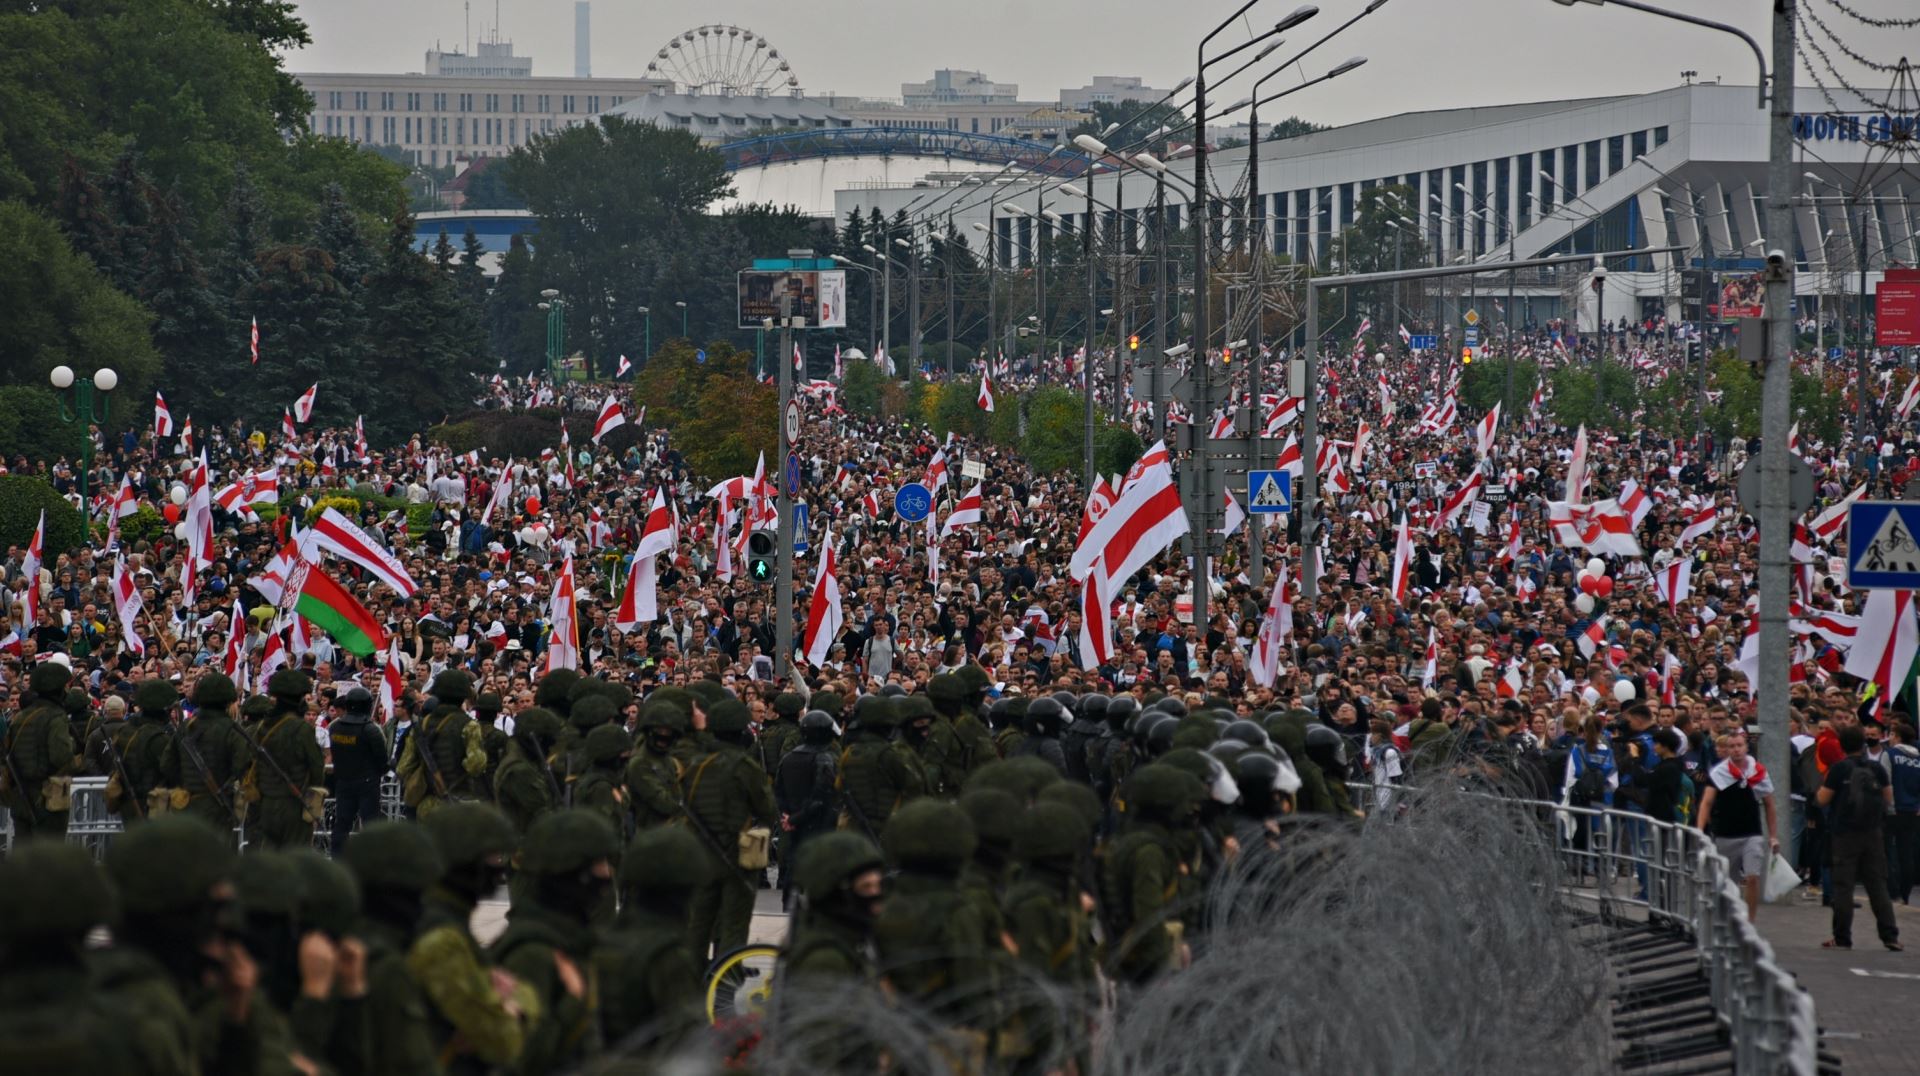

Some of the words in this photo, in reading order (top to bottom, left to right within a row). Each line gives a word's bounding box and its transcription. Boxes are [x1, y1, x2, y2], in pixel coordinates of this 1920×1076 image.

[788, 414, 796, 433] 70
[1393, 481, 1416, 490] 1984
[1895, 756, 1920, 768] ПРЭС
